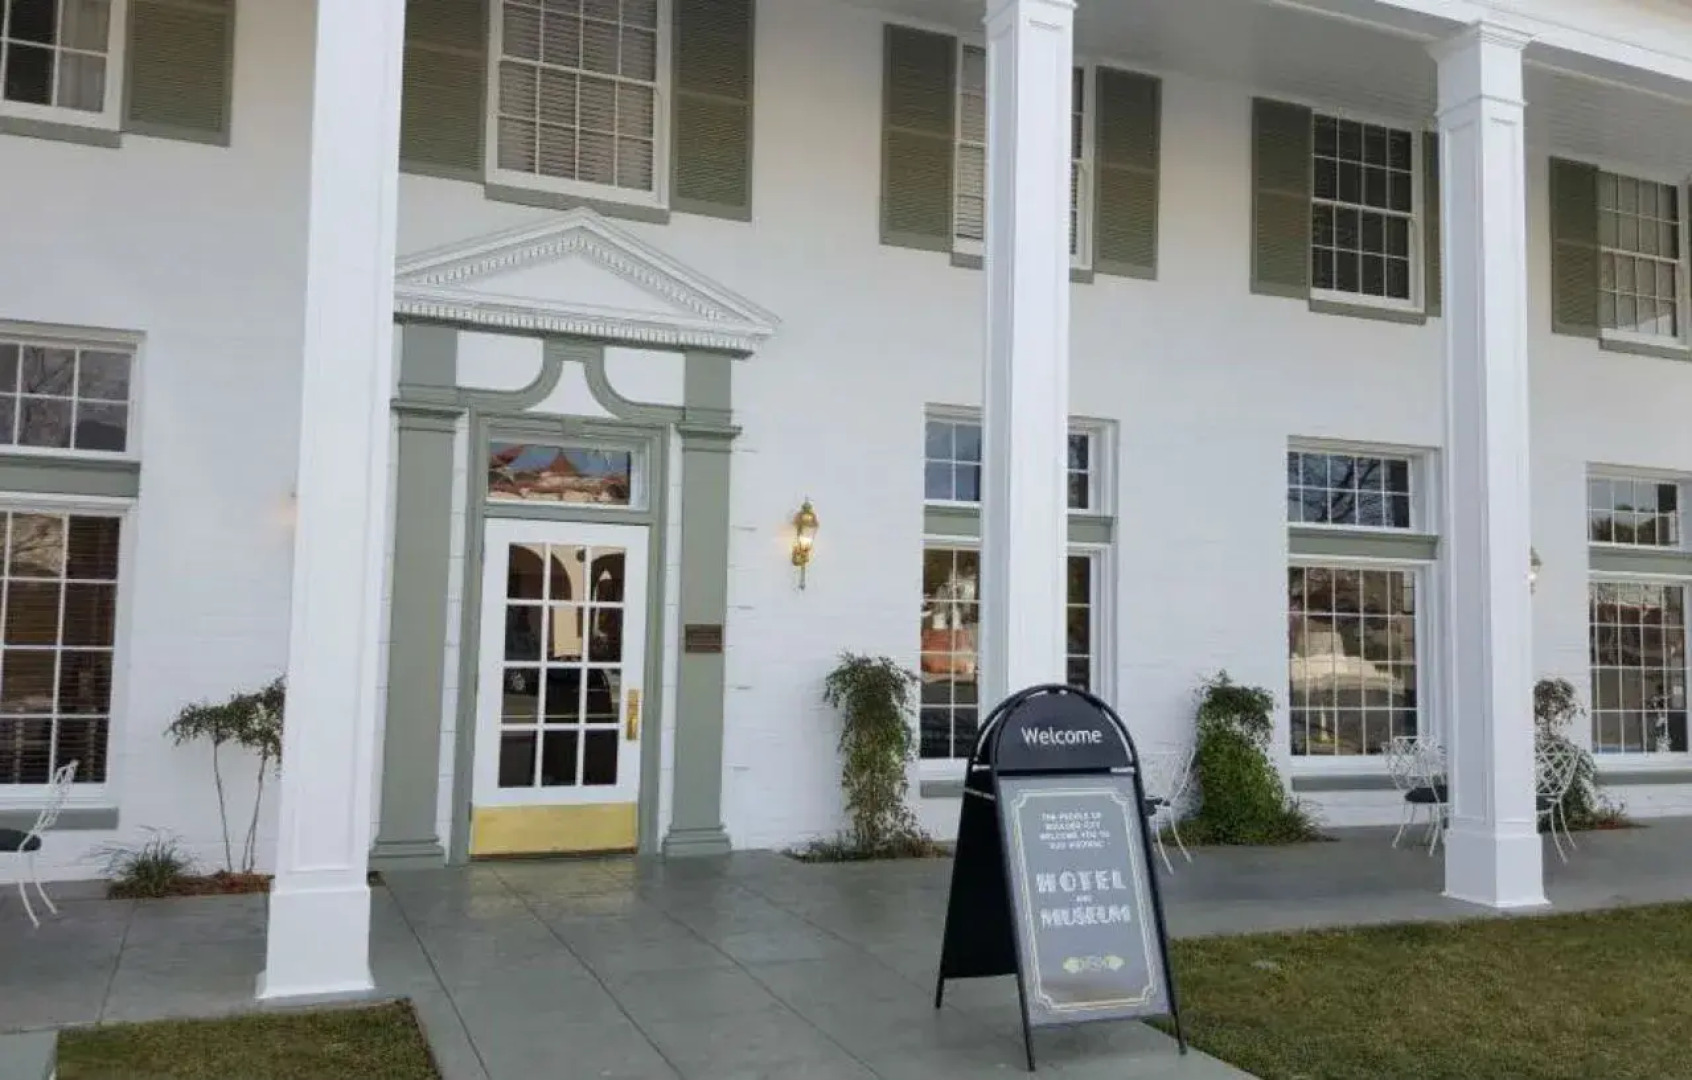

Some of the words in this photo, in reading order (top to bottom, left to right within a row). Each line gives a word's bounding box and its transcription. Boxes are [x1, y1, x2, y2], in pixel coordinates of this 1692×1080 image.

[1021, 726, 1102, 745] Welcome
[1036, 869, 1127, 893] HOTEL
[1040, 905, 1131, 927] MUSEUM
